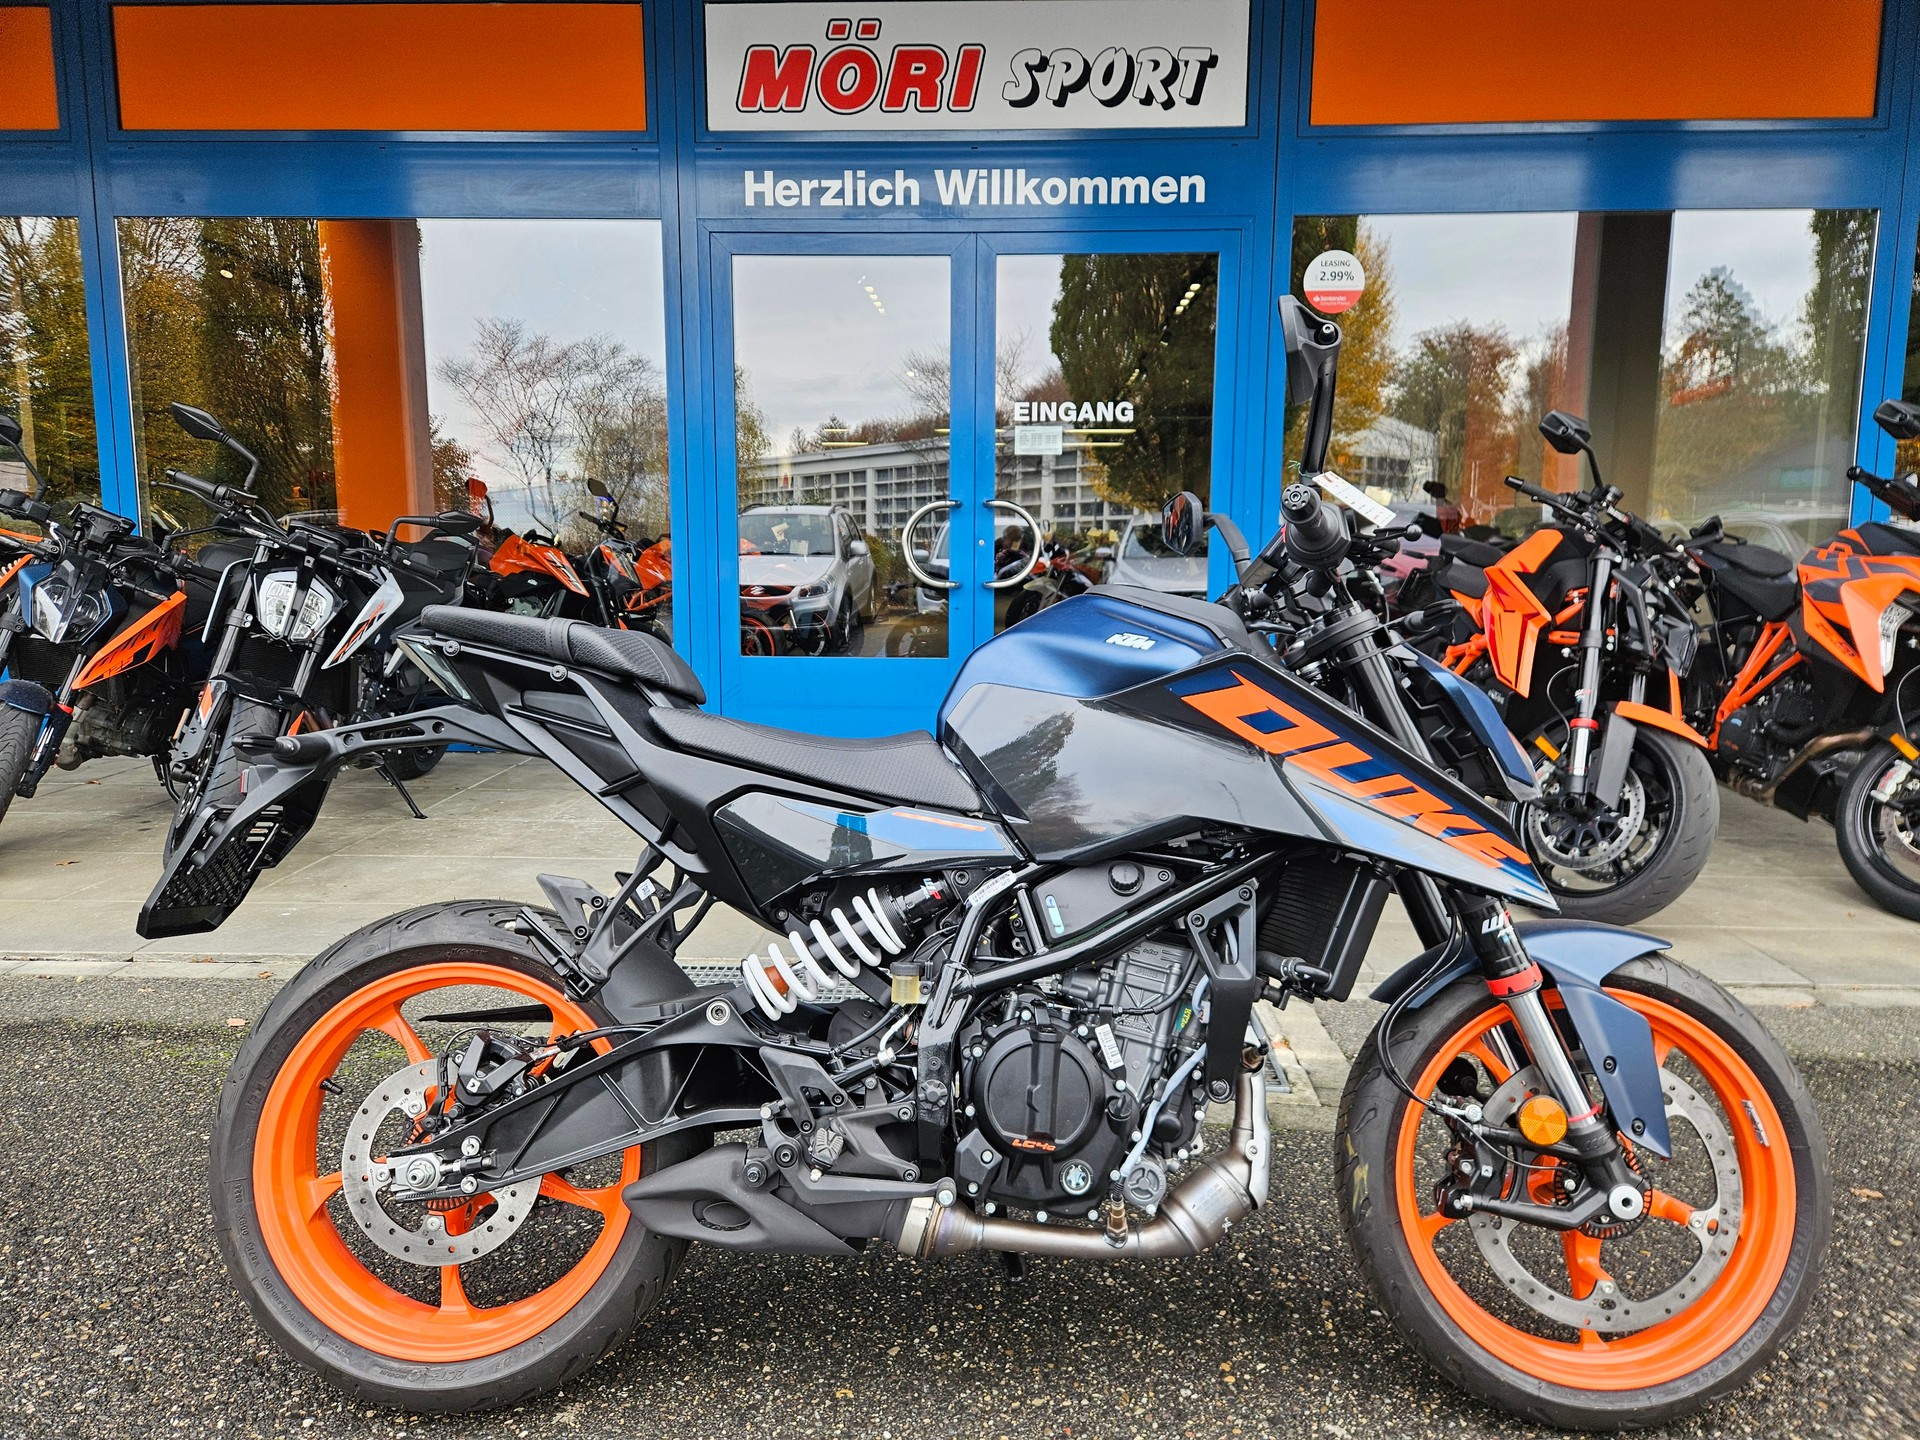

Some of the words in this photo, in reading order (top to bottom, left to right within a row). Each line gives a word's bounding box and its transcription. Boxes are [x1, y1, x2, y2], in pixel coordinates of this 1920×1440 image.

[736, 18, 986, 114] MÖRI
[1002, 46, 1219, 110] SPORT
[744, 169, 920, 207] Herzlich
[934, 168, 1206, 206] Willkommen
[1320, 259, 1351, 267] LEASING
[1320, 271, 1355, 281] 2.99%
[1014, 401, 1134, 422] EINGANG
[1105, 632, 1157, 651] KTM
[1181, 669, 1531, 868] DUKE
